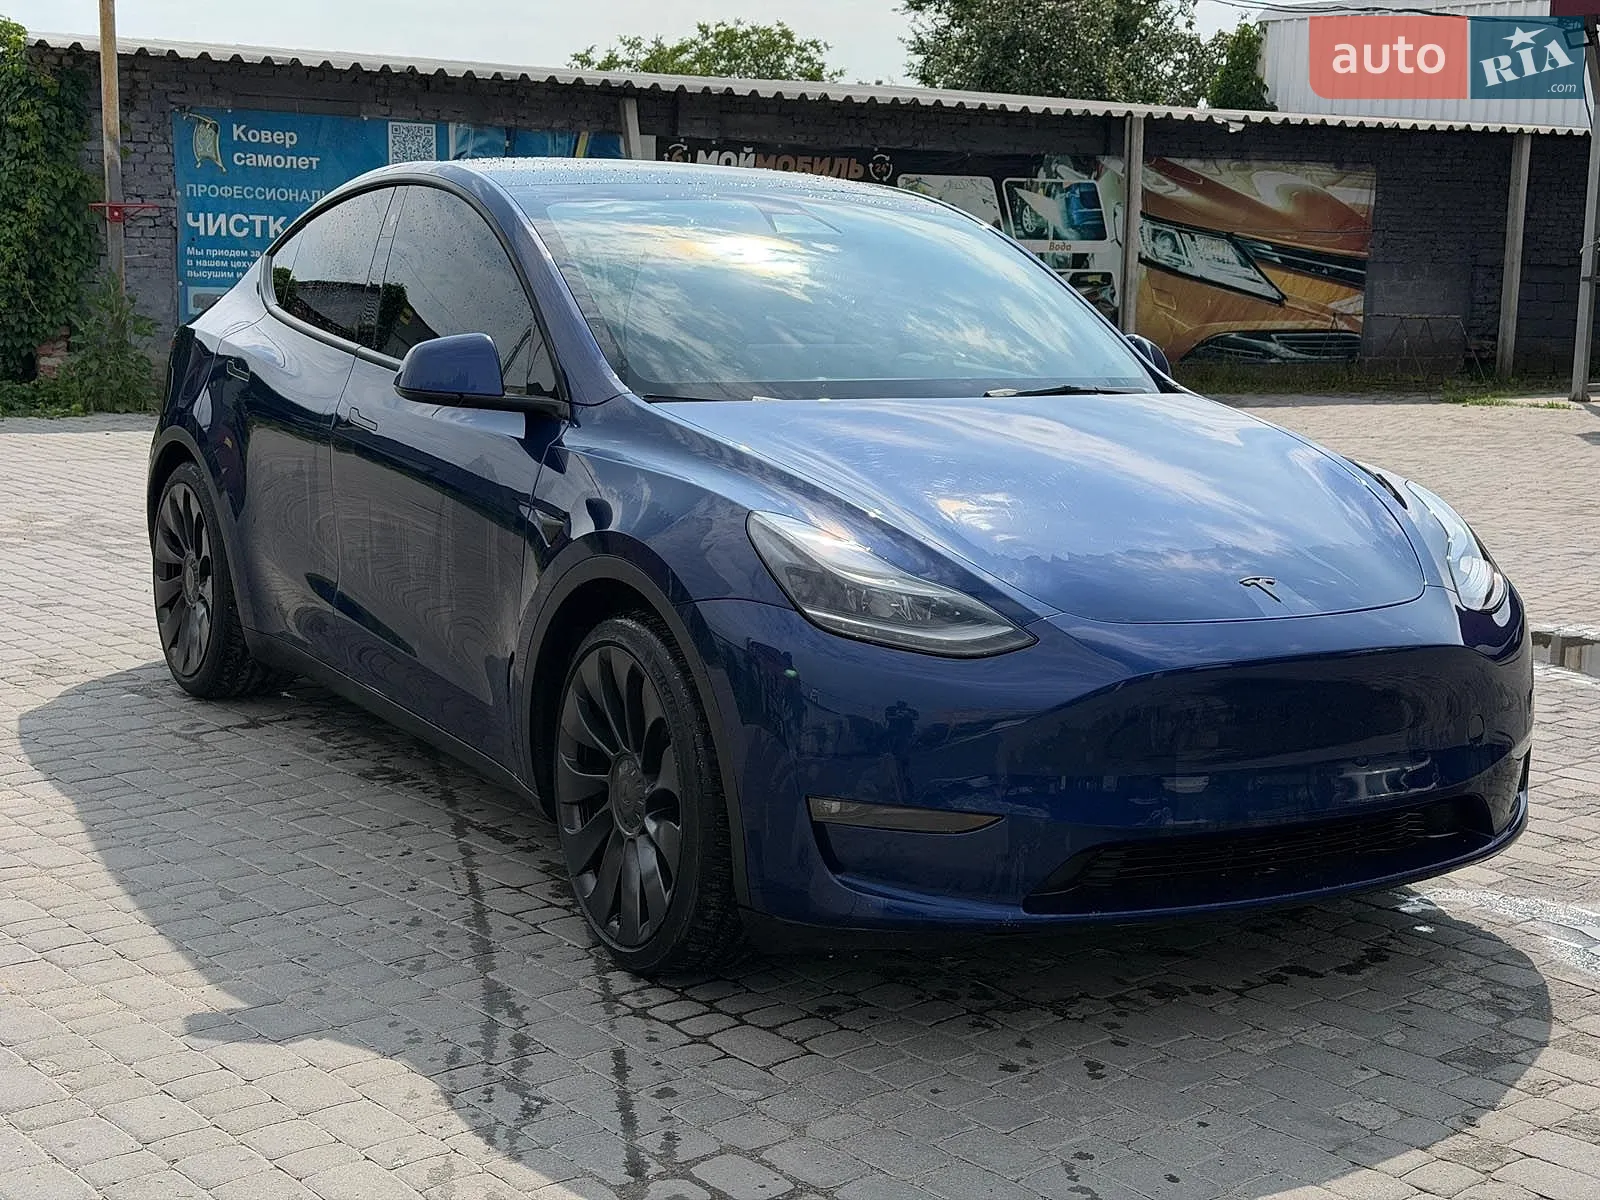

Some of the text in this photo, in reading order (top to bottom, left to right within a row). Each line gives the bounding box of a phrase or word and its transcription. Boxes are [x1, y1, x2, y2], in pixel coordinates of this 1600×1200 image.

[232, 123, 298, 148] Ковер
[233, 152, 320, 170] самолет
[186, 212, 287, 239] ЧИСТК
[187, 247, 204, 256] Мы
[1049, 242, 1072, 251] Вода
[187, 270, 234, 279] высушим
